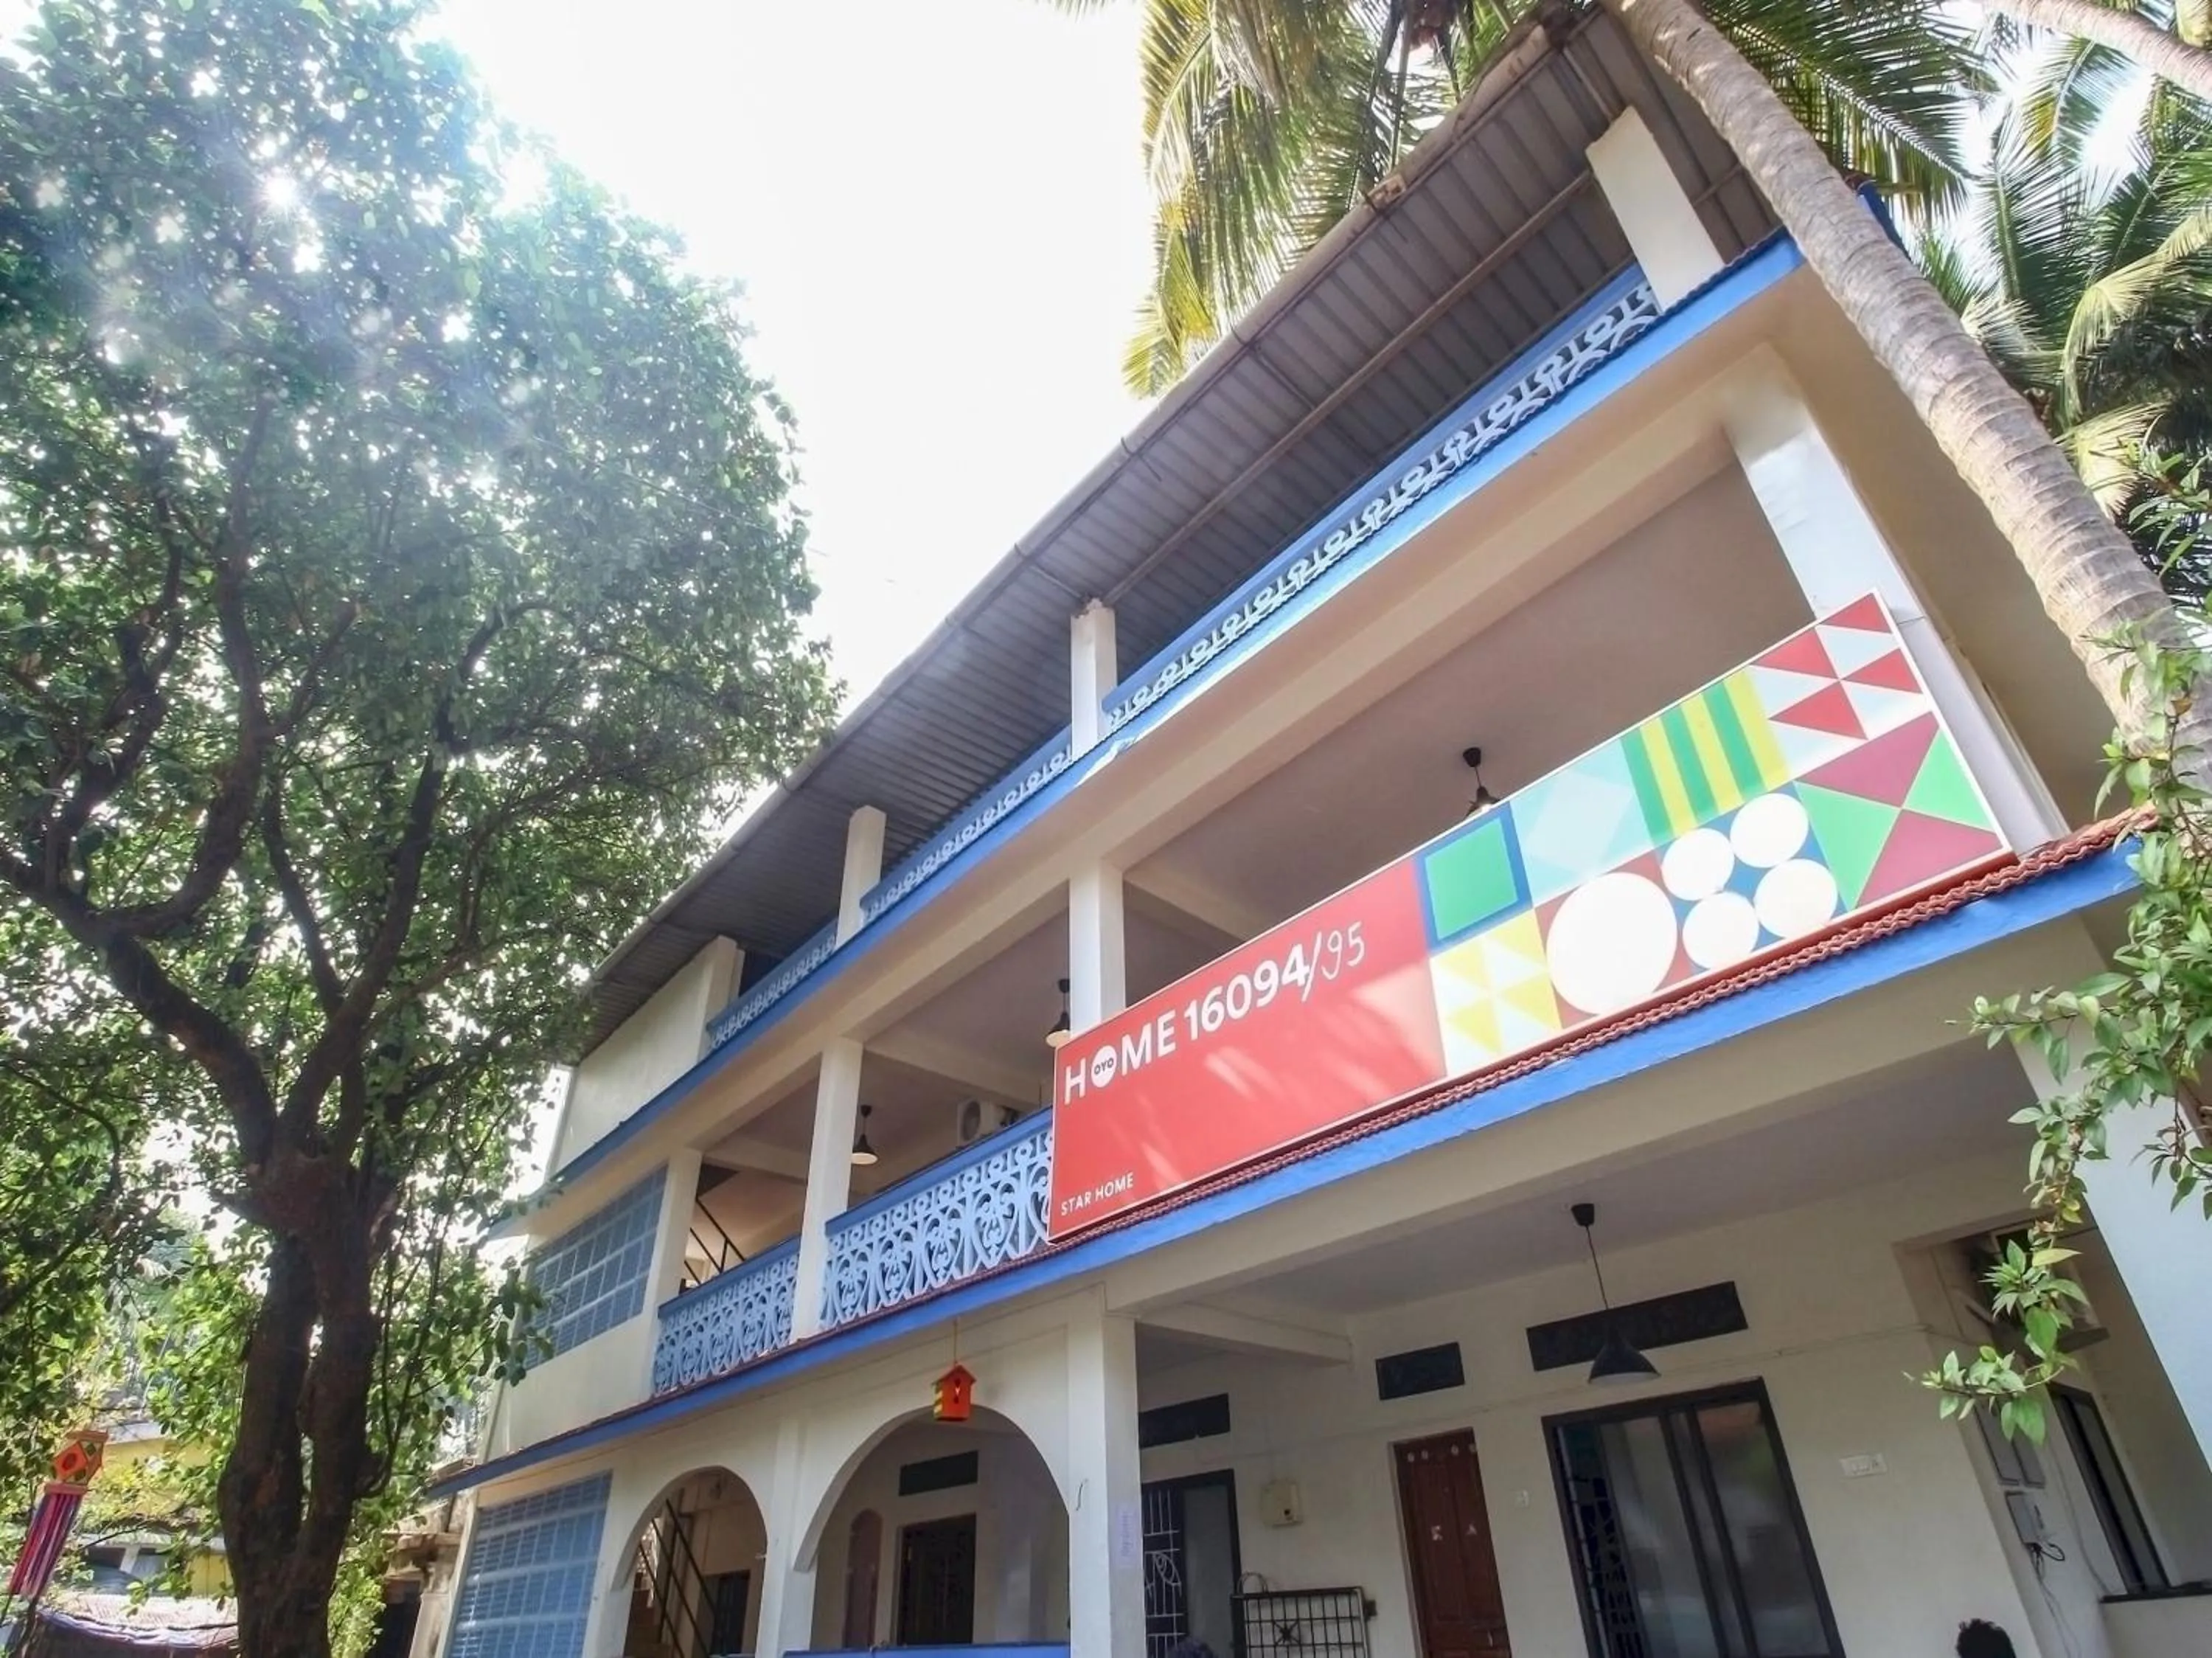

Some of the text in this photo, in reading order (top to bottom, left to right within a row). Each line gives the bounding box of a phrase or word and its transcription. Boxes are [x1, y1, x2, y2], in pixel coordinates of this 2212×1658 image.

[1093, 1058, 1114, 1075] OYO
[1061, 1172, 1133, 1215] STAR HOME
